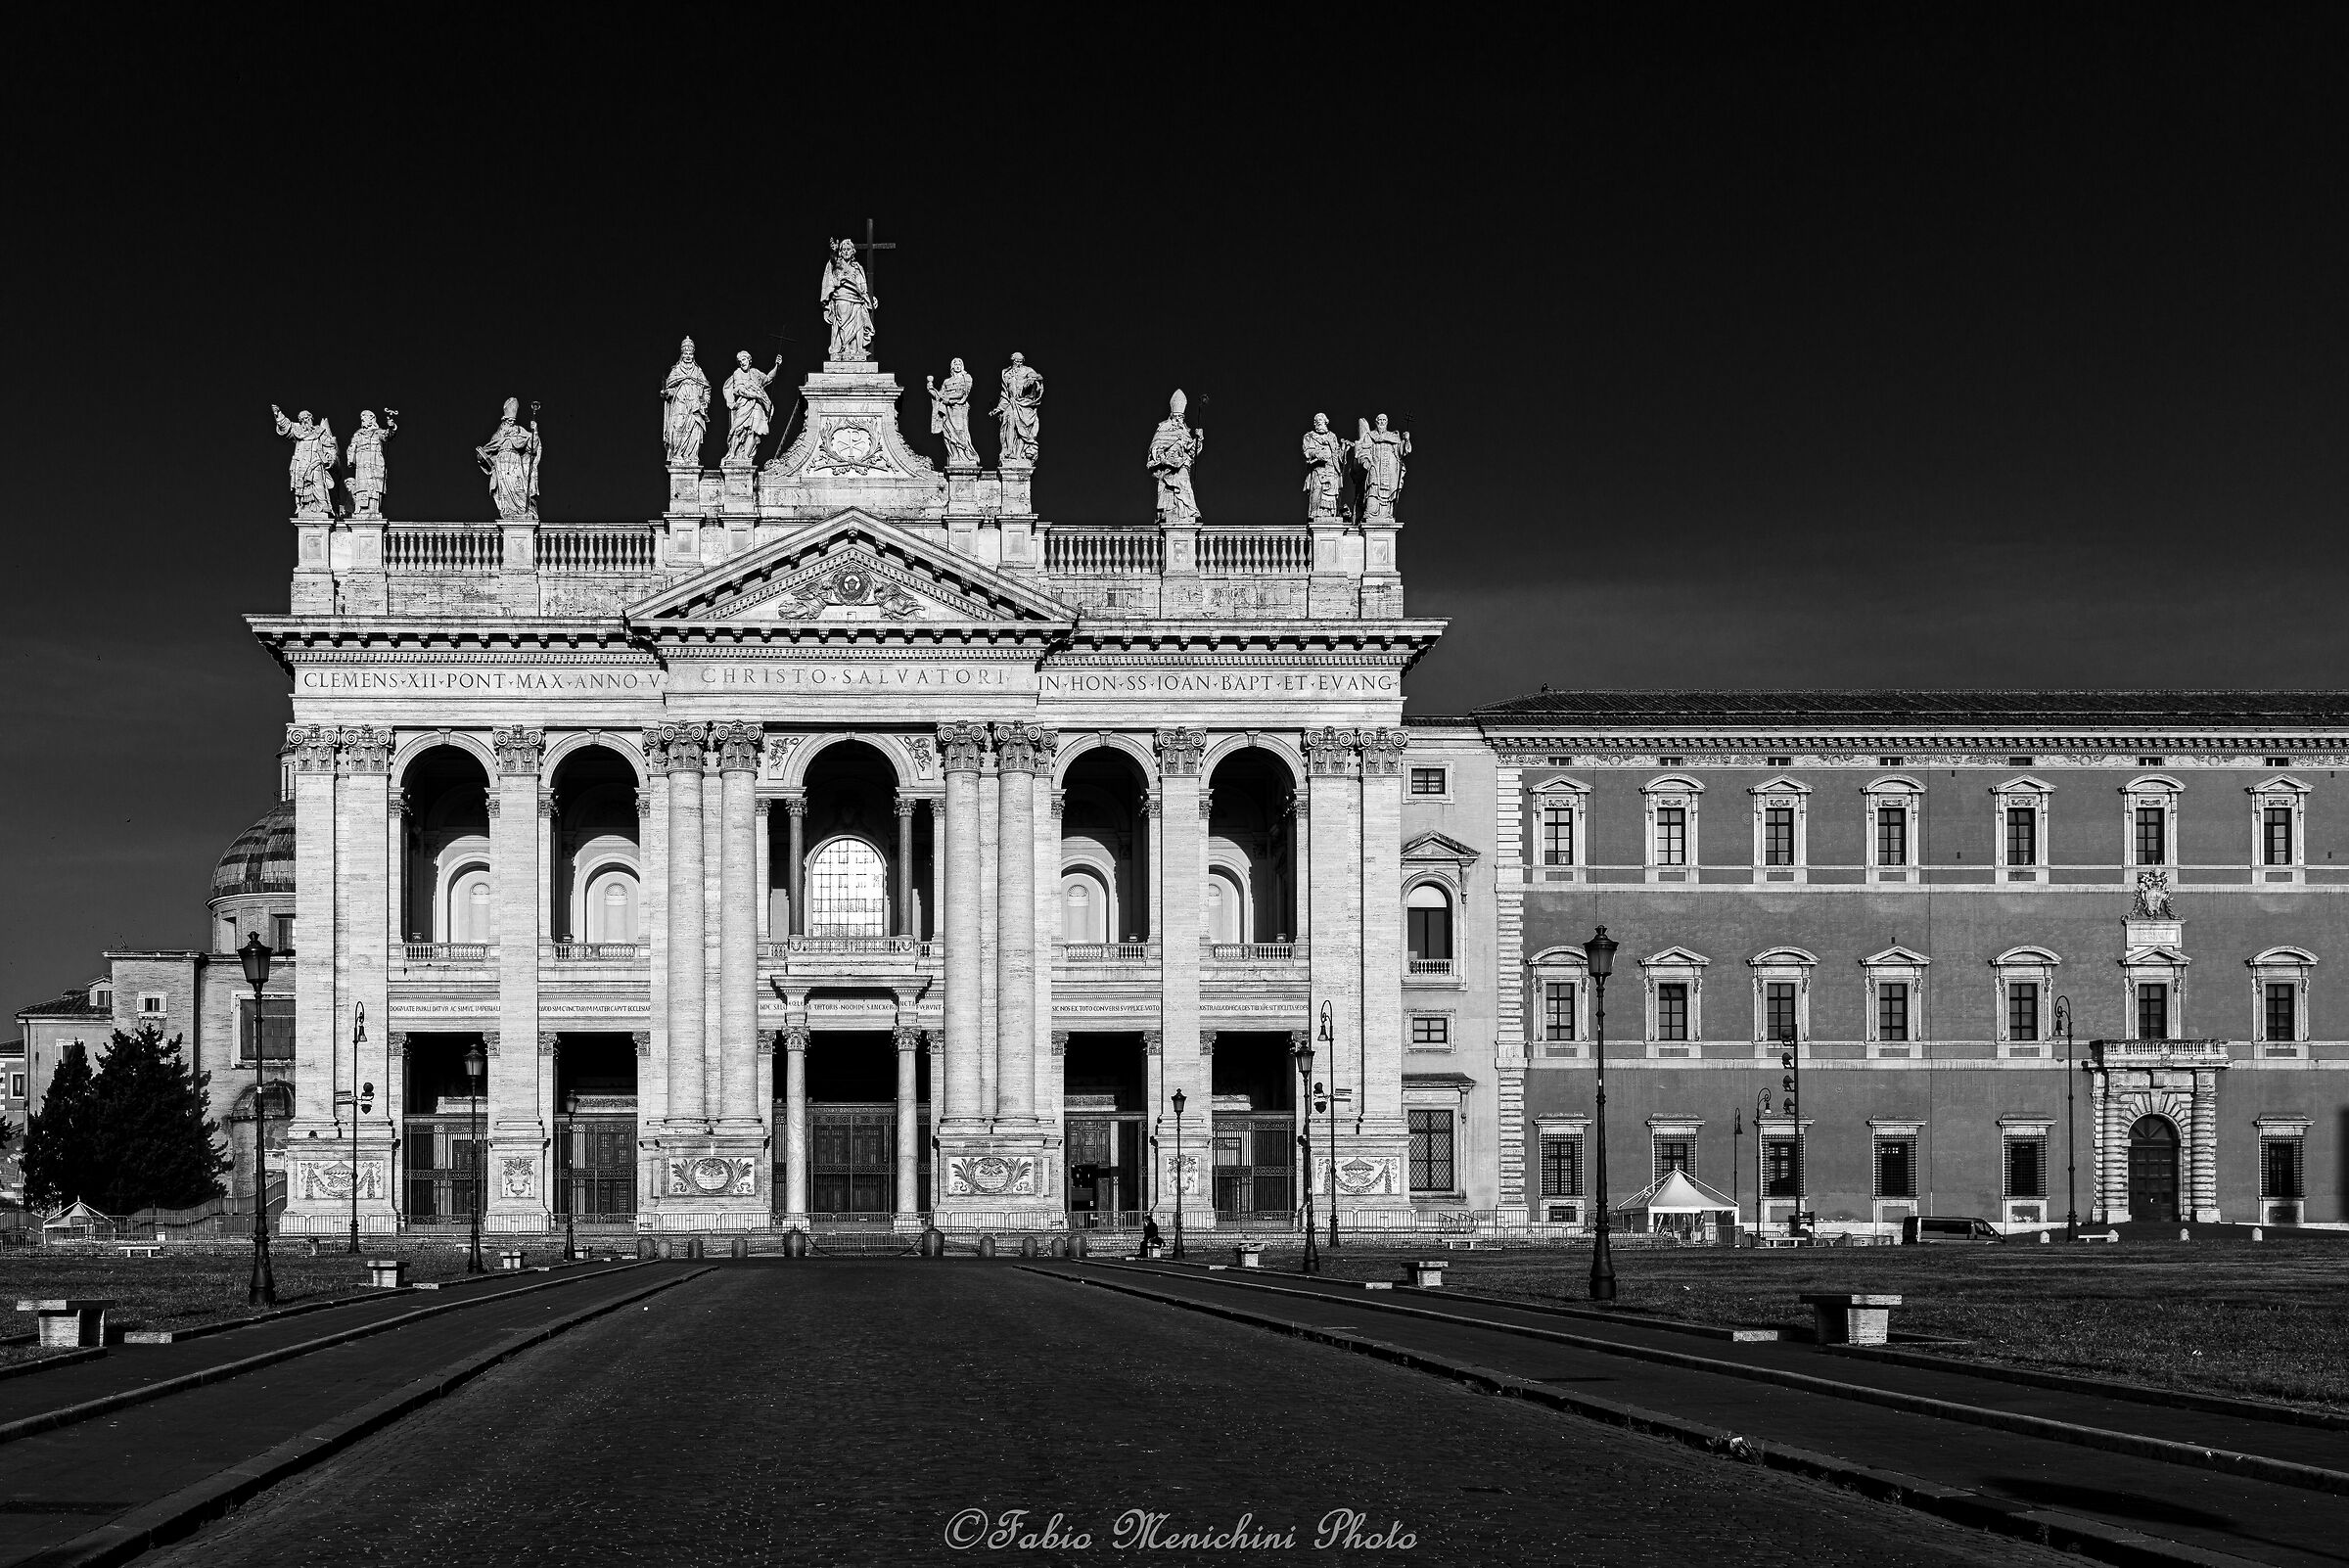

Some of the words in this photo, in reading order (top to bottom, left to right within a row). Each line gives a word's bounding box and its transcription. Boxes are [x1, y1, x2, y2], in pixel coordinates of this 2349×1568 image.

[303, 672, 398, 689] CLEMENS
[407, 672, 437, 689] XII
[446, 672, 506, 689] PONT
[516, 673, 565, 689] MAX
[575, 673, 638, 689] ANNO
[701, 668, 826, 684] CHRISTO
[842, 669, 1004, 684] SALVATORI
[1037, 675, 1060, 691] IN
[1071, 675, 1117, 691] HON
[1127, 675, 1147, 691] SS
[1157, 675, 1211, 691] IOAN
[1221, 675, 1274, 691] BAPT
[1283, 675, 1309, 691] ET
[1318, 675, 1393, 691] EVANG
